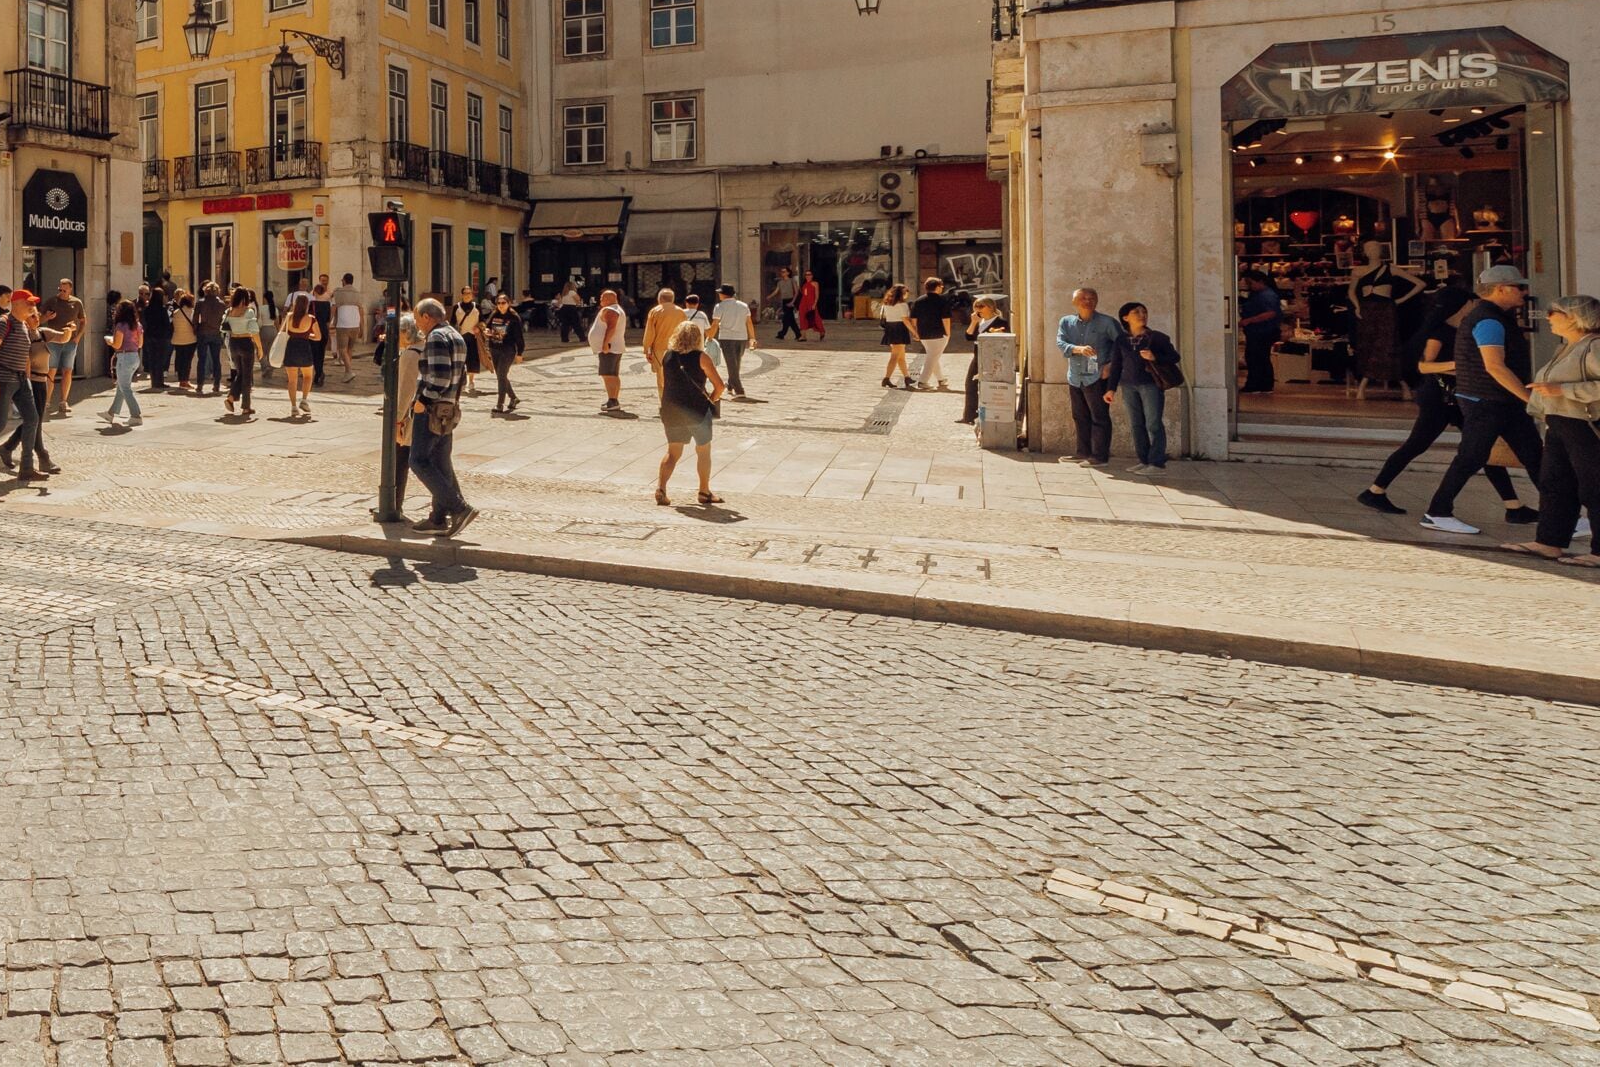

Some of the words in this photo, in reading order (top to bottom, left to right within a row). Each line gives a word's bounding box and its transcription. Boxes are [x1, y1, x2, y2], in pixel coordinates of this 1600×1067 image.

[1370, 14, 1396, 33] 15
[1377, 77, 1498, 95] underwear
[772, 184, 880, 216] Signature
[29, 214, 86, 233] MultiOpticas
